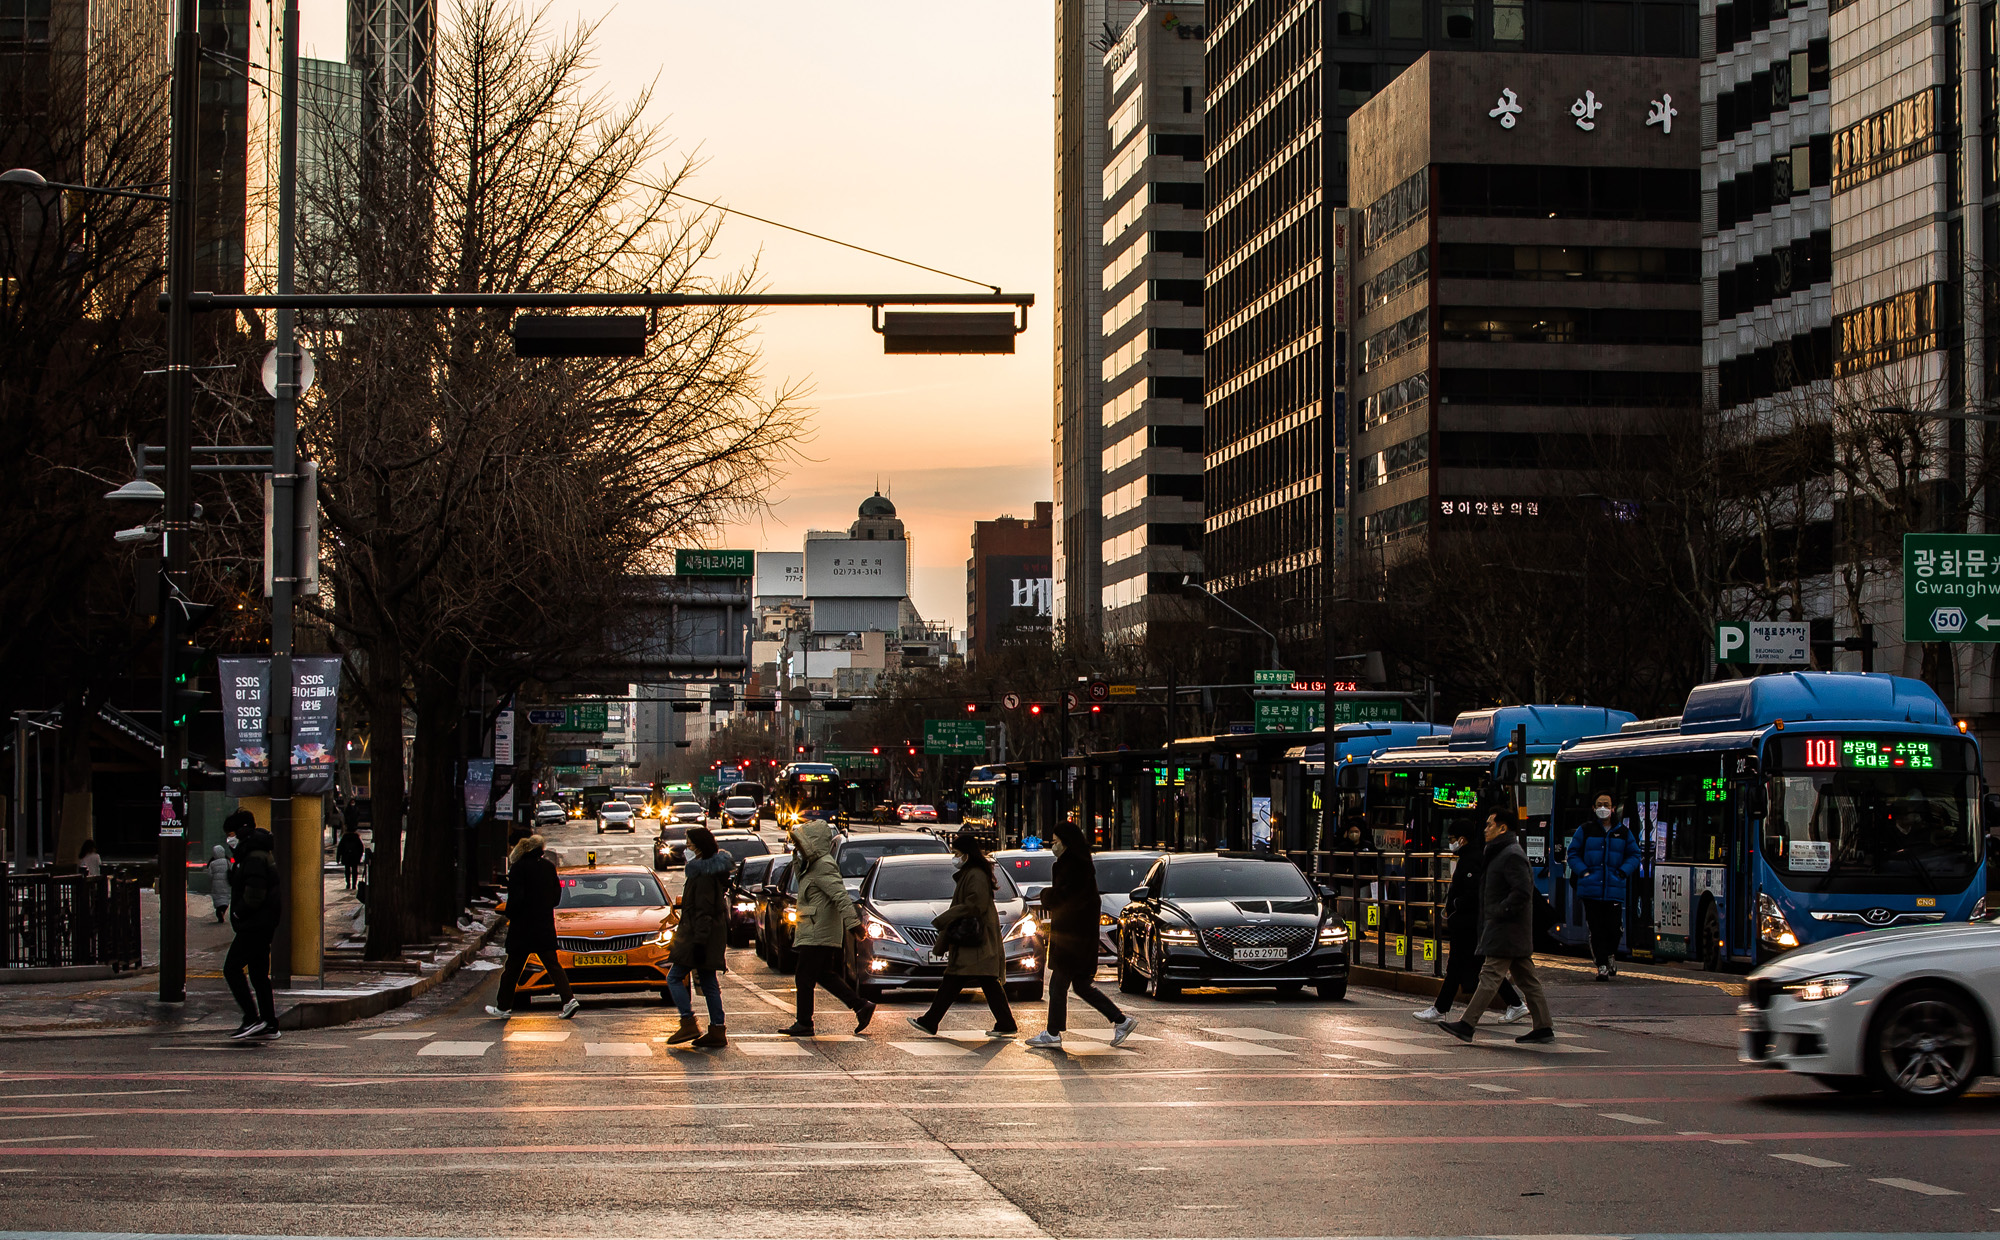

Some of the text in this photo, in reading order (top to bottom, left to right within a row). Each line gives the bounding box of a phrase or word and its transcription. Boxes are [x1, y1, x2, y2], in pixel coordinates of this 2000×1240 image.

[685, 555, 745, 569] 세종대로사거리
[1913, 549, 1988, 578] 광화문
[1938, 613, 1959, 627] 50
[1719, 626, 1744, 659] P
[1093, 686, 1105, 696] 50
[1260, 705, 1299, 716] 종로구청
[1318, 703, 1351, 713] 흥지문
[1358, 706, 1379, 717] 시청
[1806, 740, 1838, 767] 101
[1843, 741, 1877, 754] 쌍문역
[1895, 742, 1929, 755] 수유역
[1854, 754, 1889, 768] 동대문
[1910, 755, 1933, 768] 종로
[601, 955, 624, 964] 3628
[1262, 949, 1284, 958] 2970
